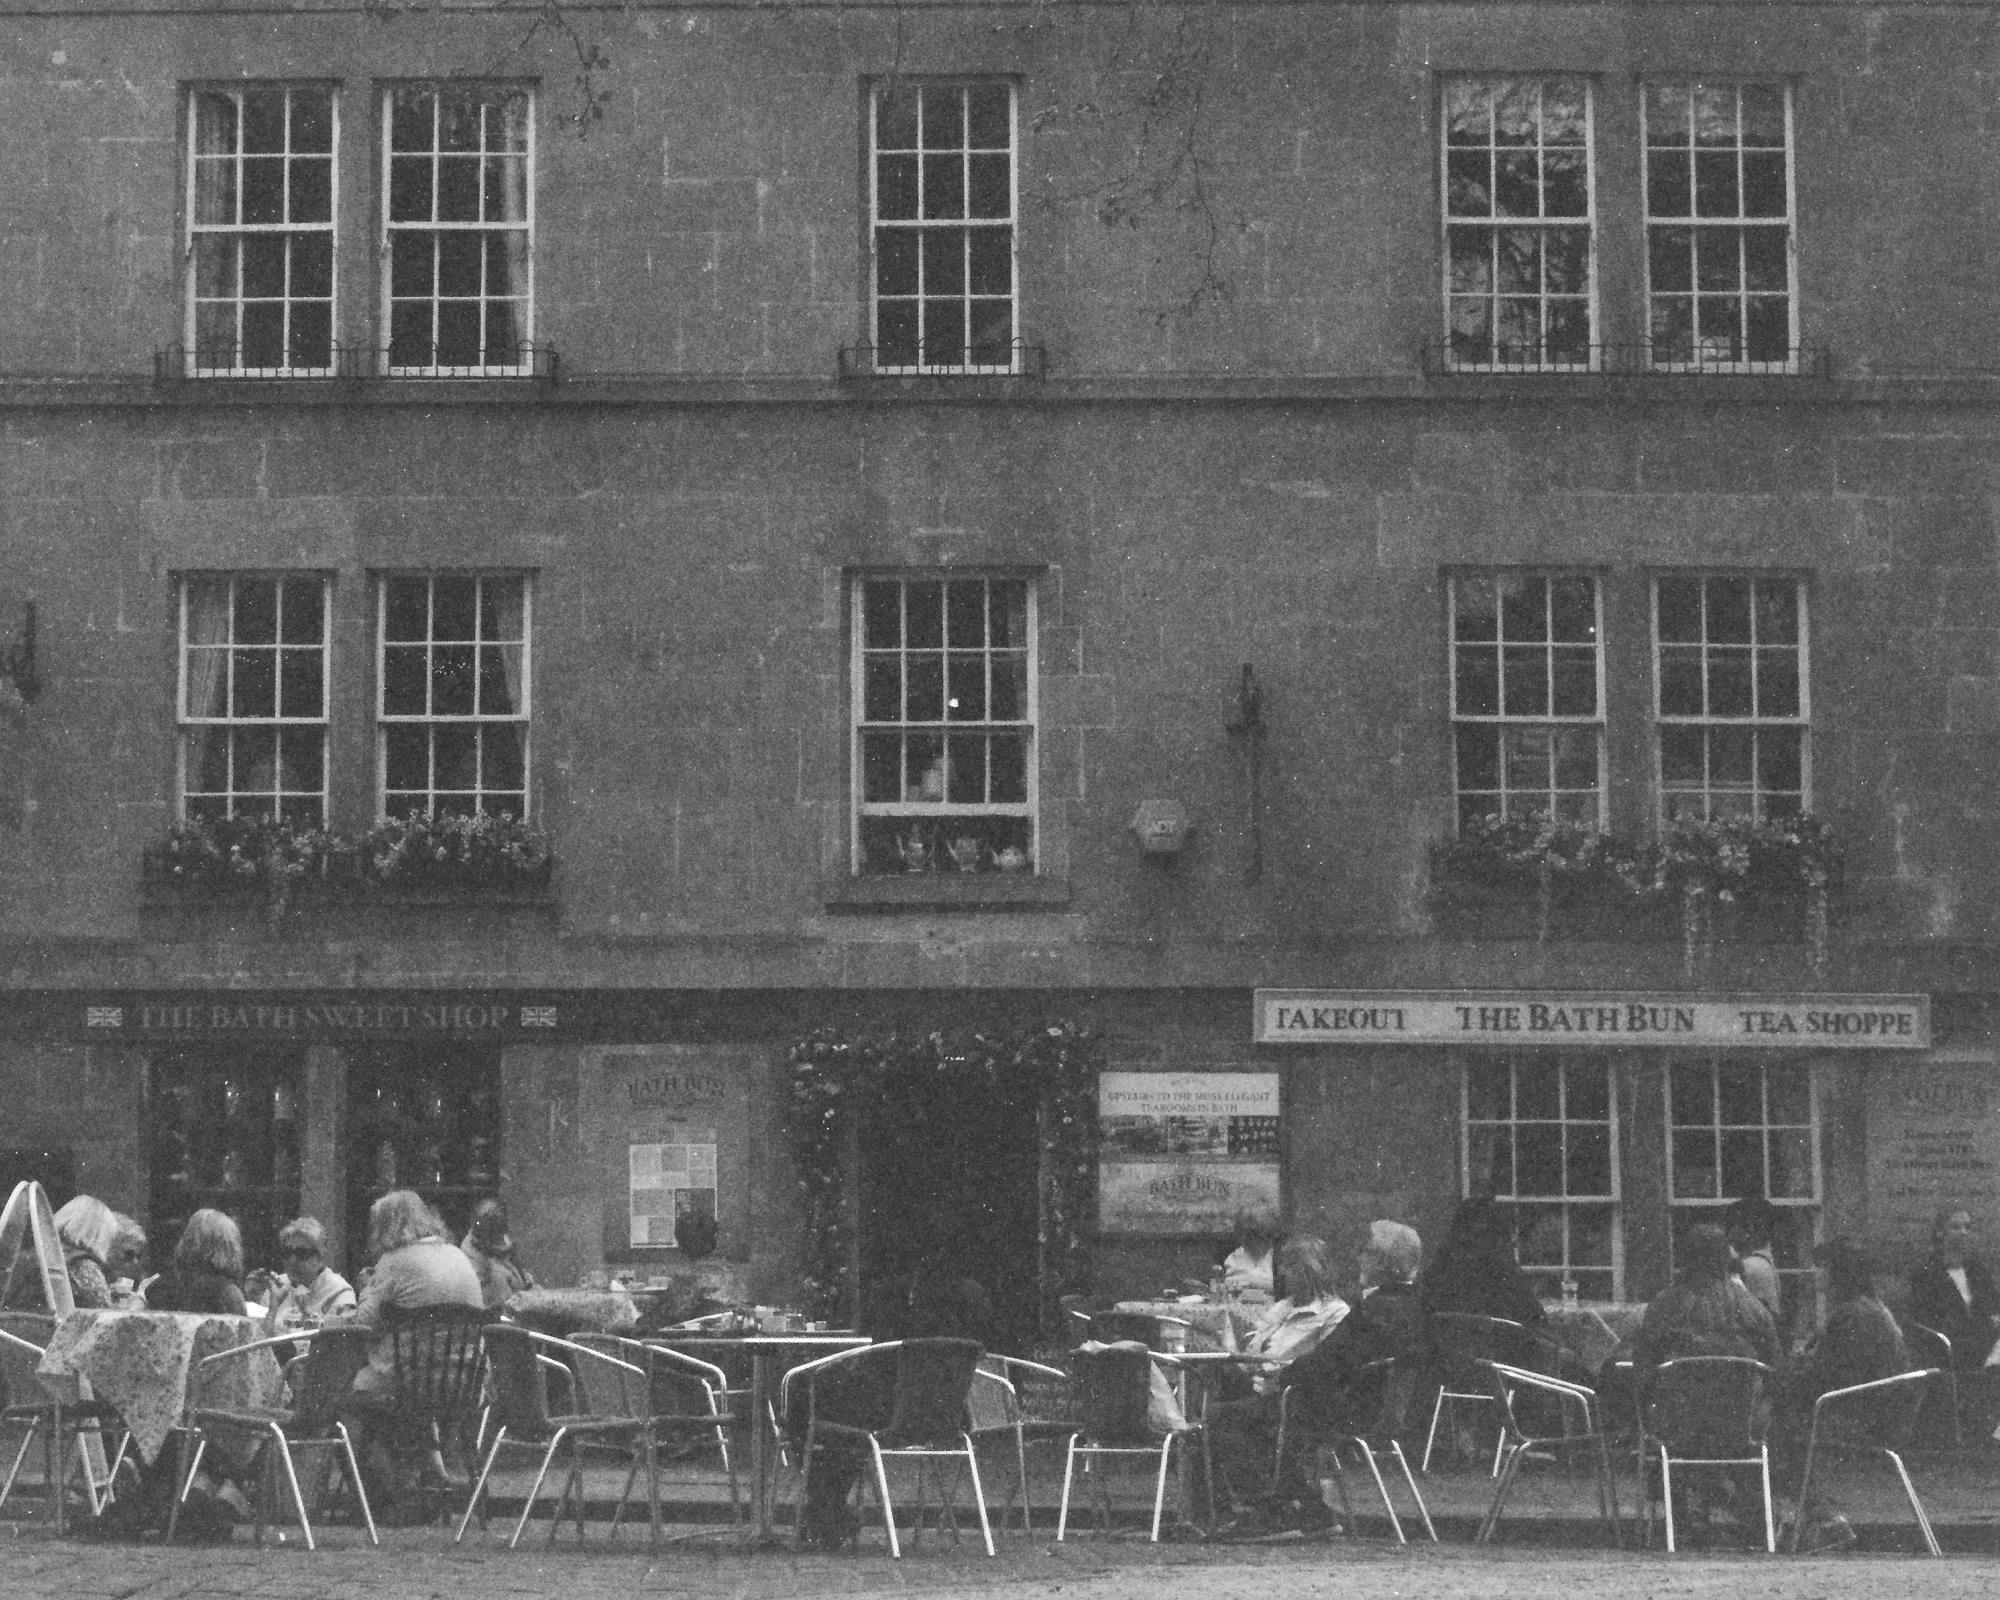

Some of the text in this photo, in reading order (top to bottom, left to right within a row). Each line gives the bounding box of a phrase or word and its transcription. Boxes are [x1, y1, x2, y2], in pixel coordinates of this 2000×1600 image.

[139, 1005, 508, 1029] THE BATH SWEET SHOP
[1276, 1007, 1406, 1030] TAKEOUT
[1455, 1003, 1695, 1032] THE BATH BUN
[1738, 1010, 1913, 1035] TEA SHOPPE
[1107, 1092, 1270, 1102] UPSTAIRS TO THE MOST ELEGANT
[1212, 1103, 1238, 1113] BATH
[1150, 1175, 1192, 1195] BATH
